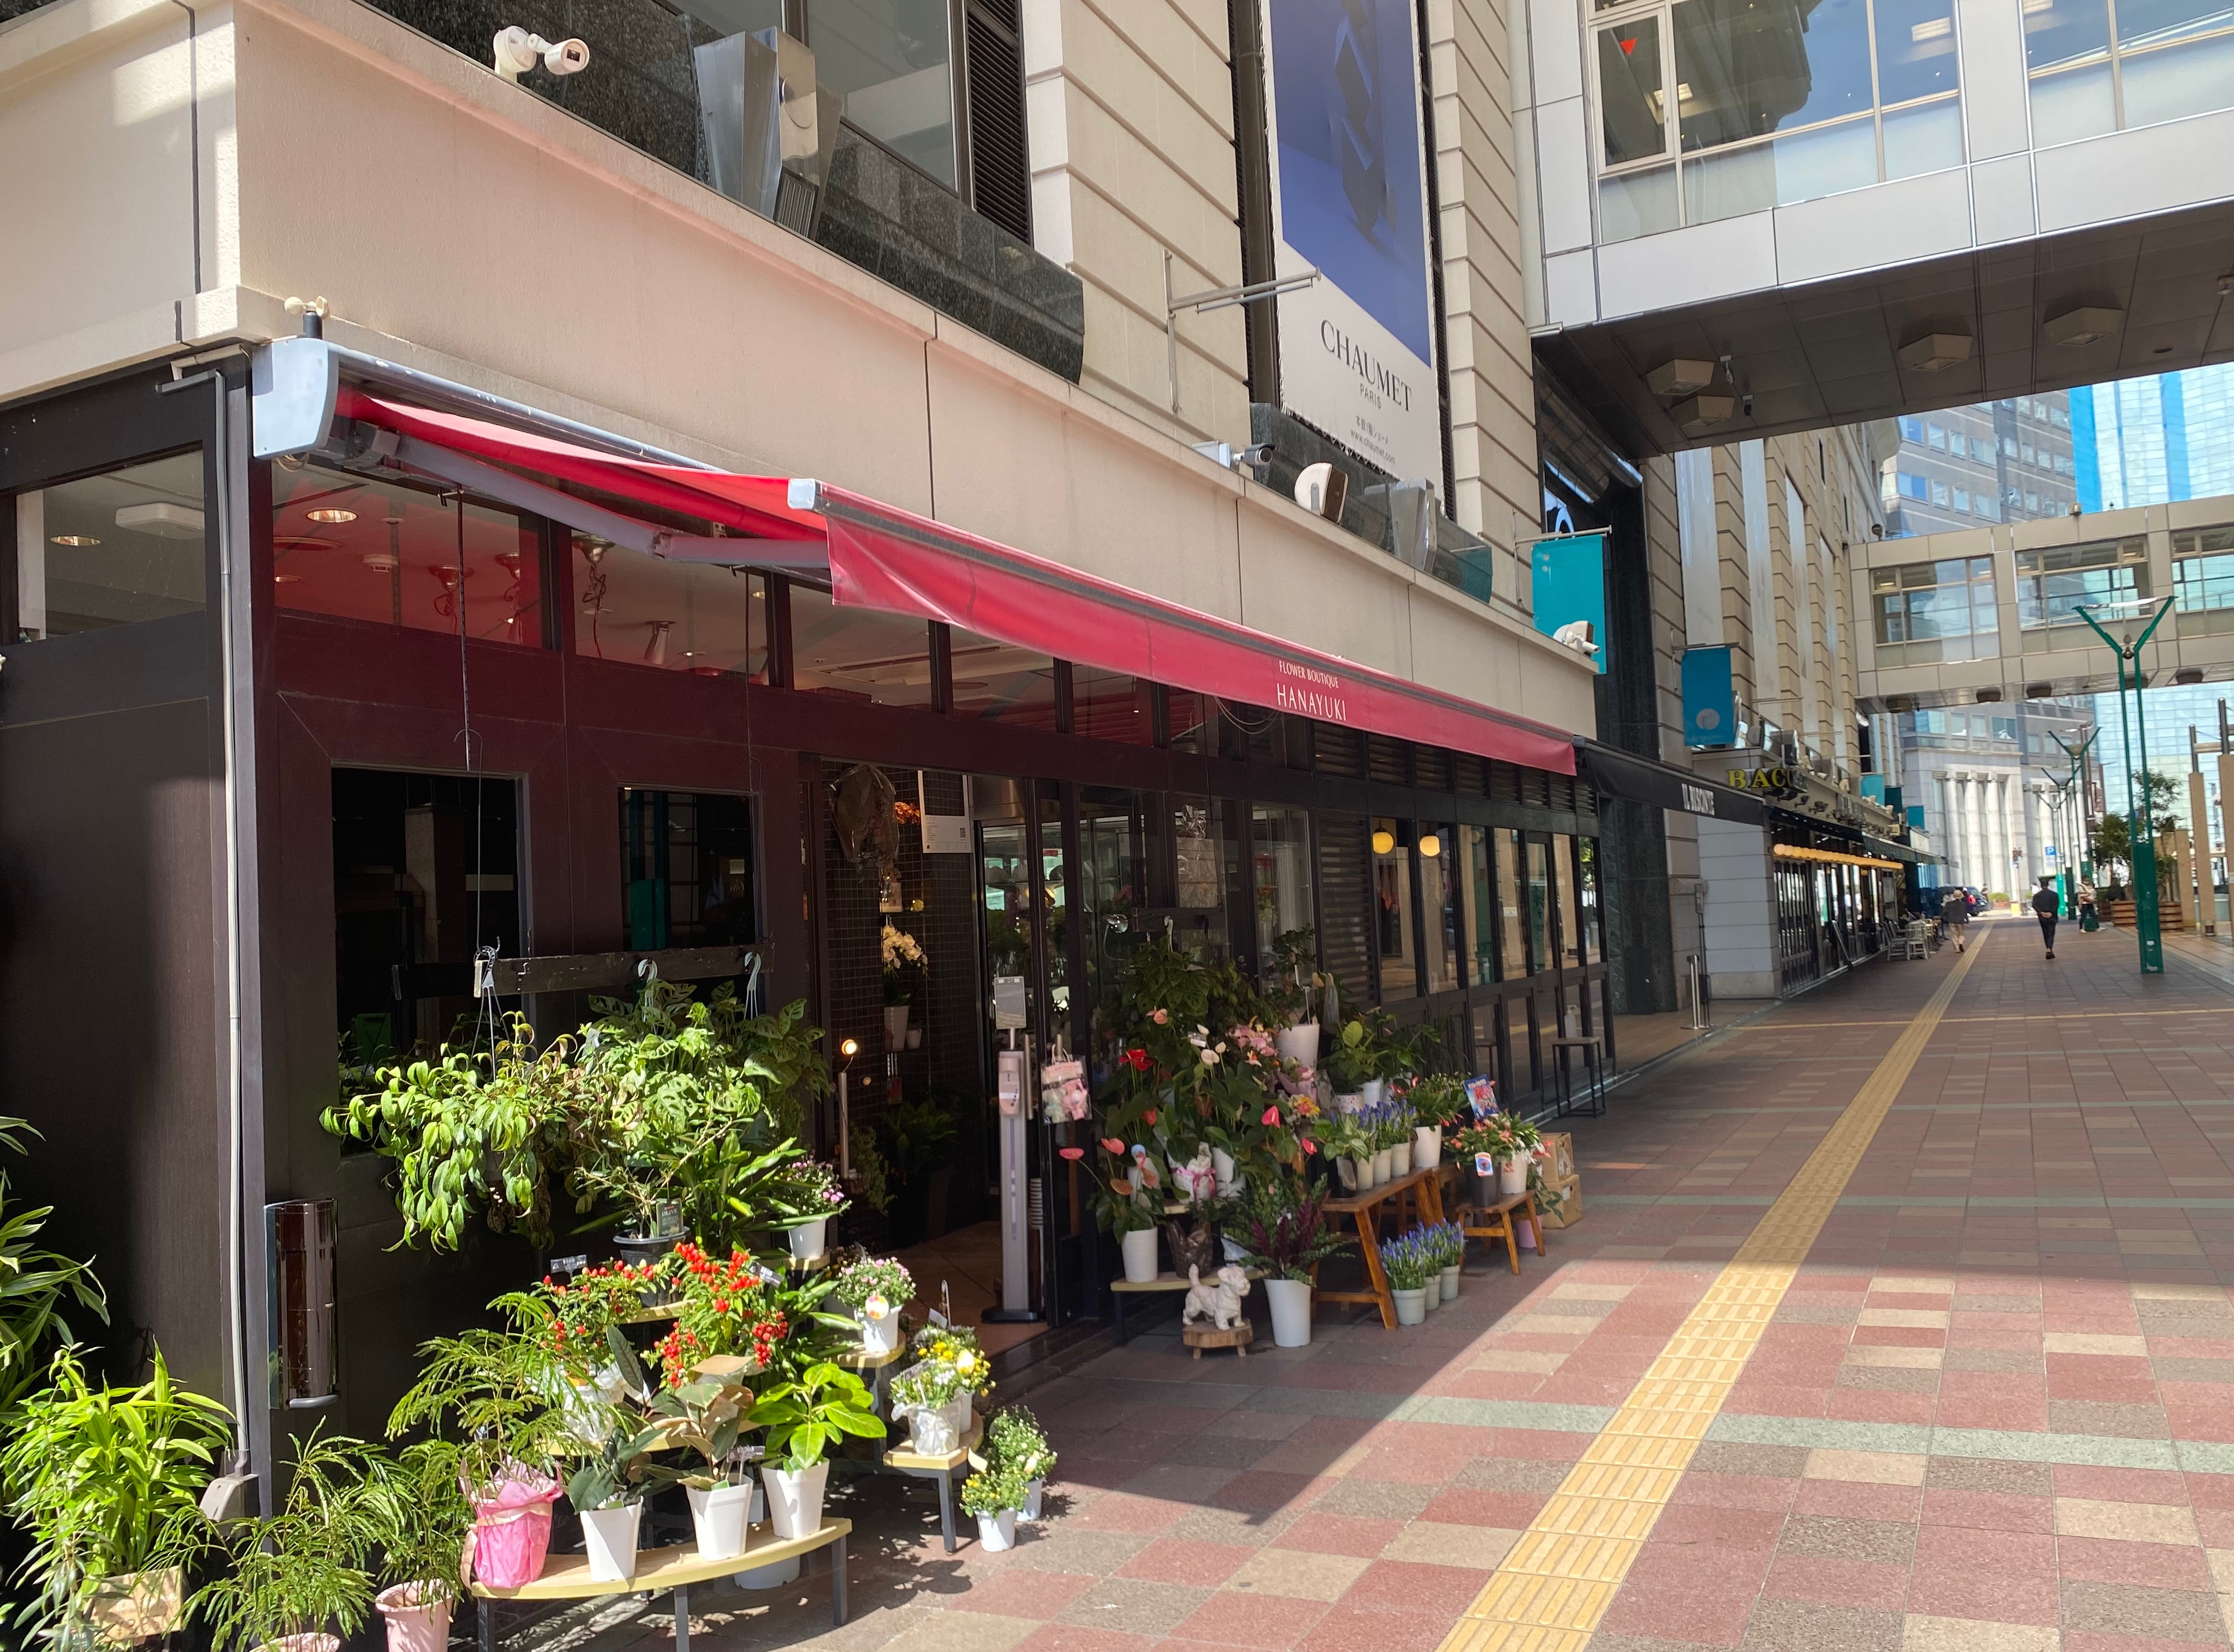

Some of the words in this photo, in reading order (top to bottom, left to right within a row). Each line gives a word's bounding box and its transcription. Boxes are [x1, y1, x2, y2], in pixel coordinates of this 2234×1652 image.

[1320, 319, 1412, 412] CHAUMET
[1360, 382, 1382, 410] PARIS
[1350, 429, 1396, 464] www.chaumet.com
[1279, 660, 1306, 679] FLOWER
[1307, 669, 1339, 689] BOUTIQUE
[1277, 683, 1346, 721] HANAYUKI
[662, 1208, 677, 1216] OLIVE
